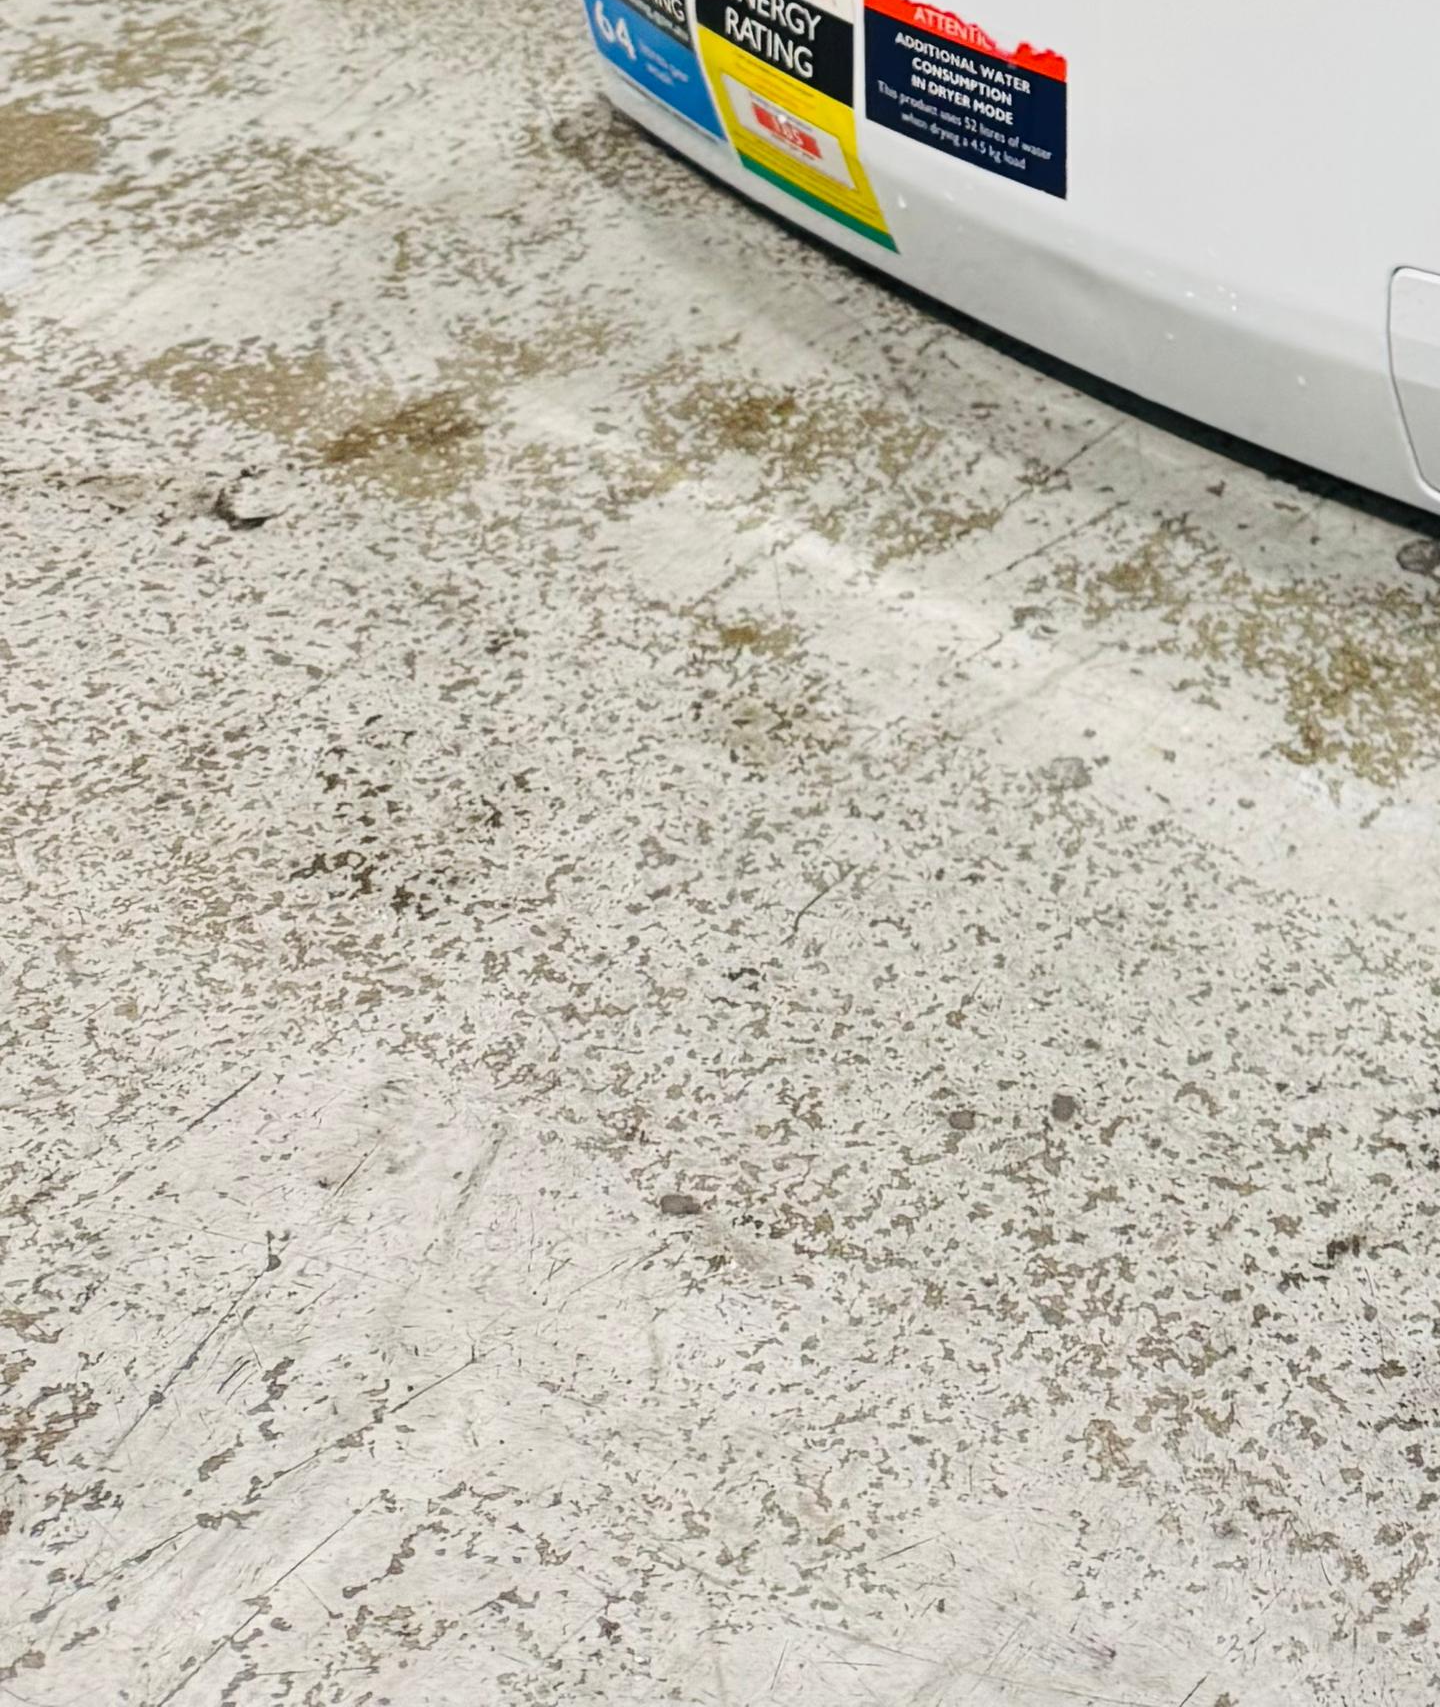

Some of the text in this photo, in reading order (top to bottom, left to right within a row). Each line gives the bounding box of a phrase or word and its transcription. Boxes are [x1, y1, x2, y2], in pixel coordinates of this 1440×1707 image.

[595, 0, 637, 61] 64
[725, 6, 814, 78] RATING
[914, 6, 990, 51] ATTENTI
[895, 32, 1031, 94] ADDITIONAL WATER
[912, 57, 1012, 106] CONSUMPTION
[911, 74, 1014, 126] IN DRYER MODE
[964, 117, 978, 133] 52
